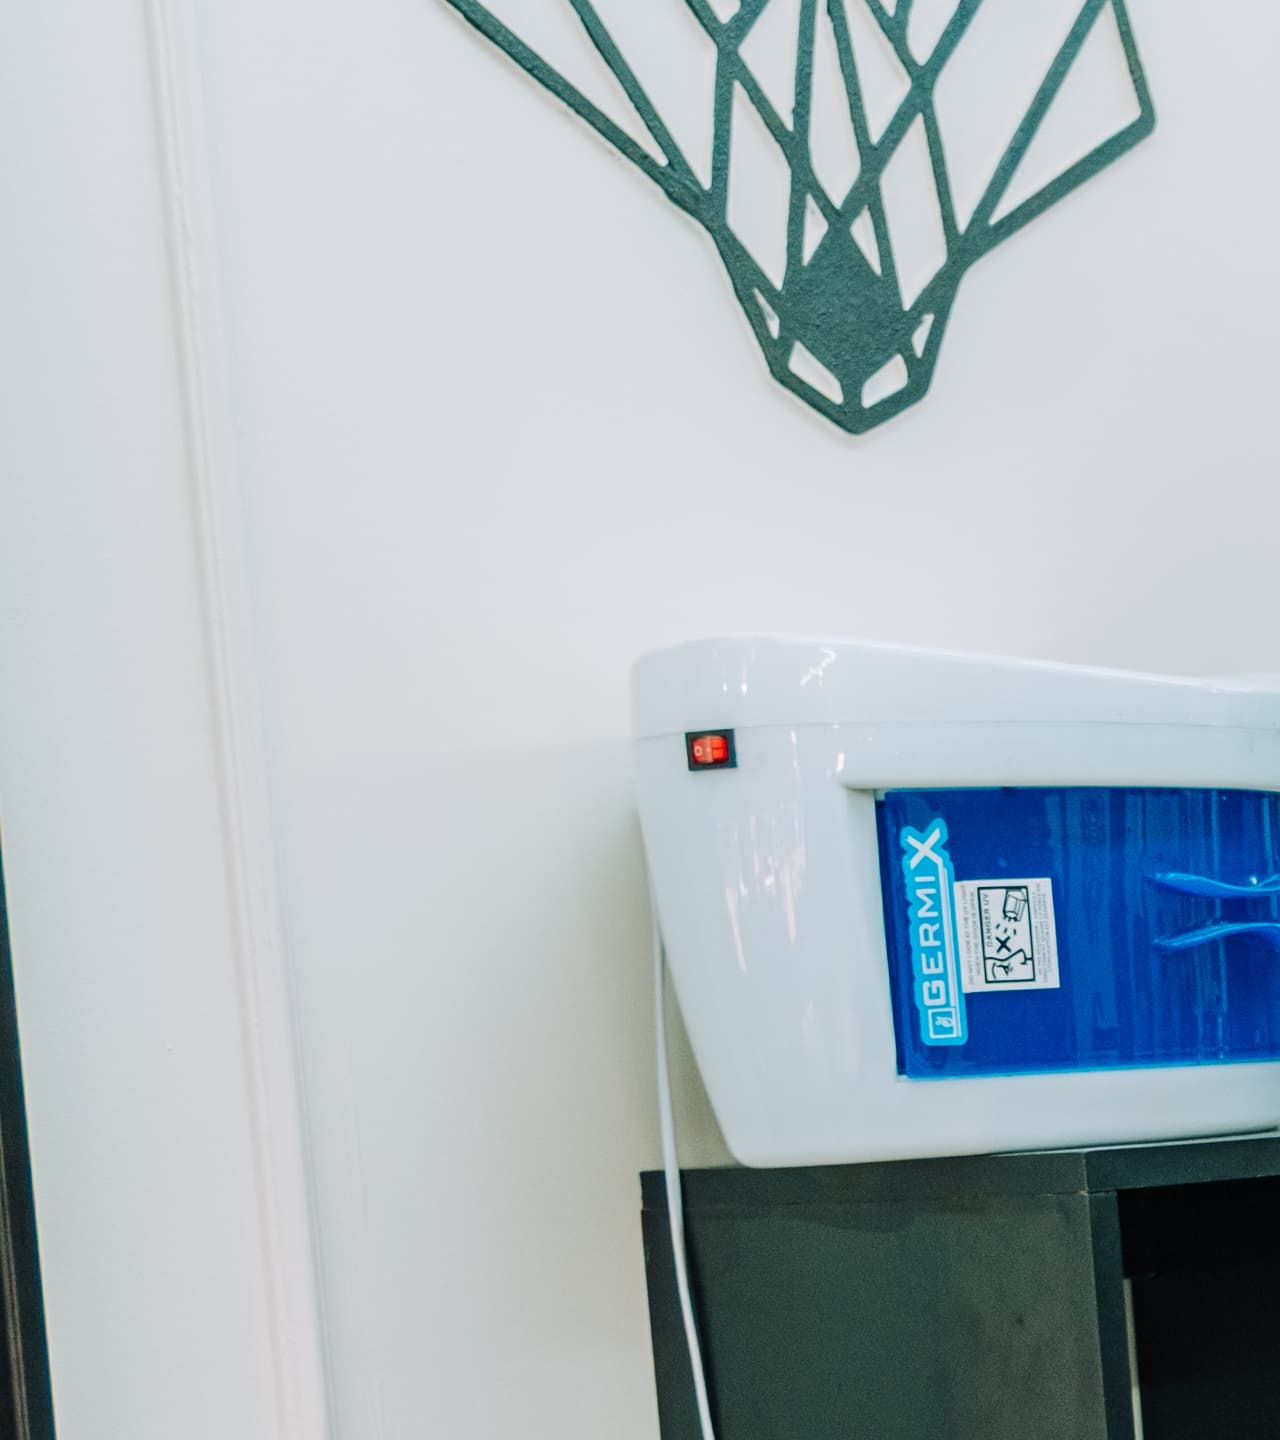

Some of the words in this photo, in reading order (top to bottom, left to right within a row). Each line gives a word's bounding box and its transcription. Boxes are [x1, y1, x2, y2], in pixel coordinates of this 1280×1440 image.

[907, 828, 947, 1006] GERMIX
[982, 892, 991, 906] UV
[983, 908, 992, 947] DANGER
